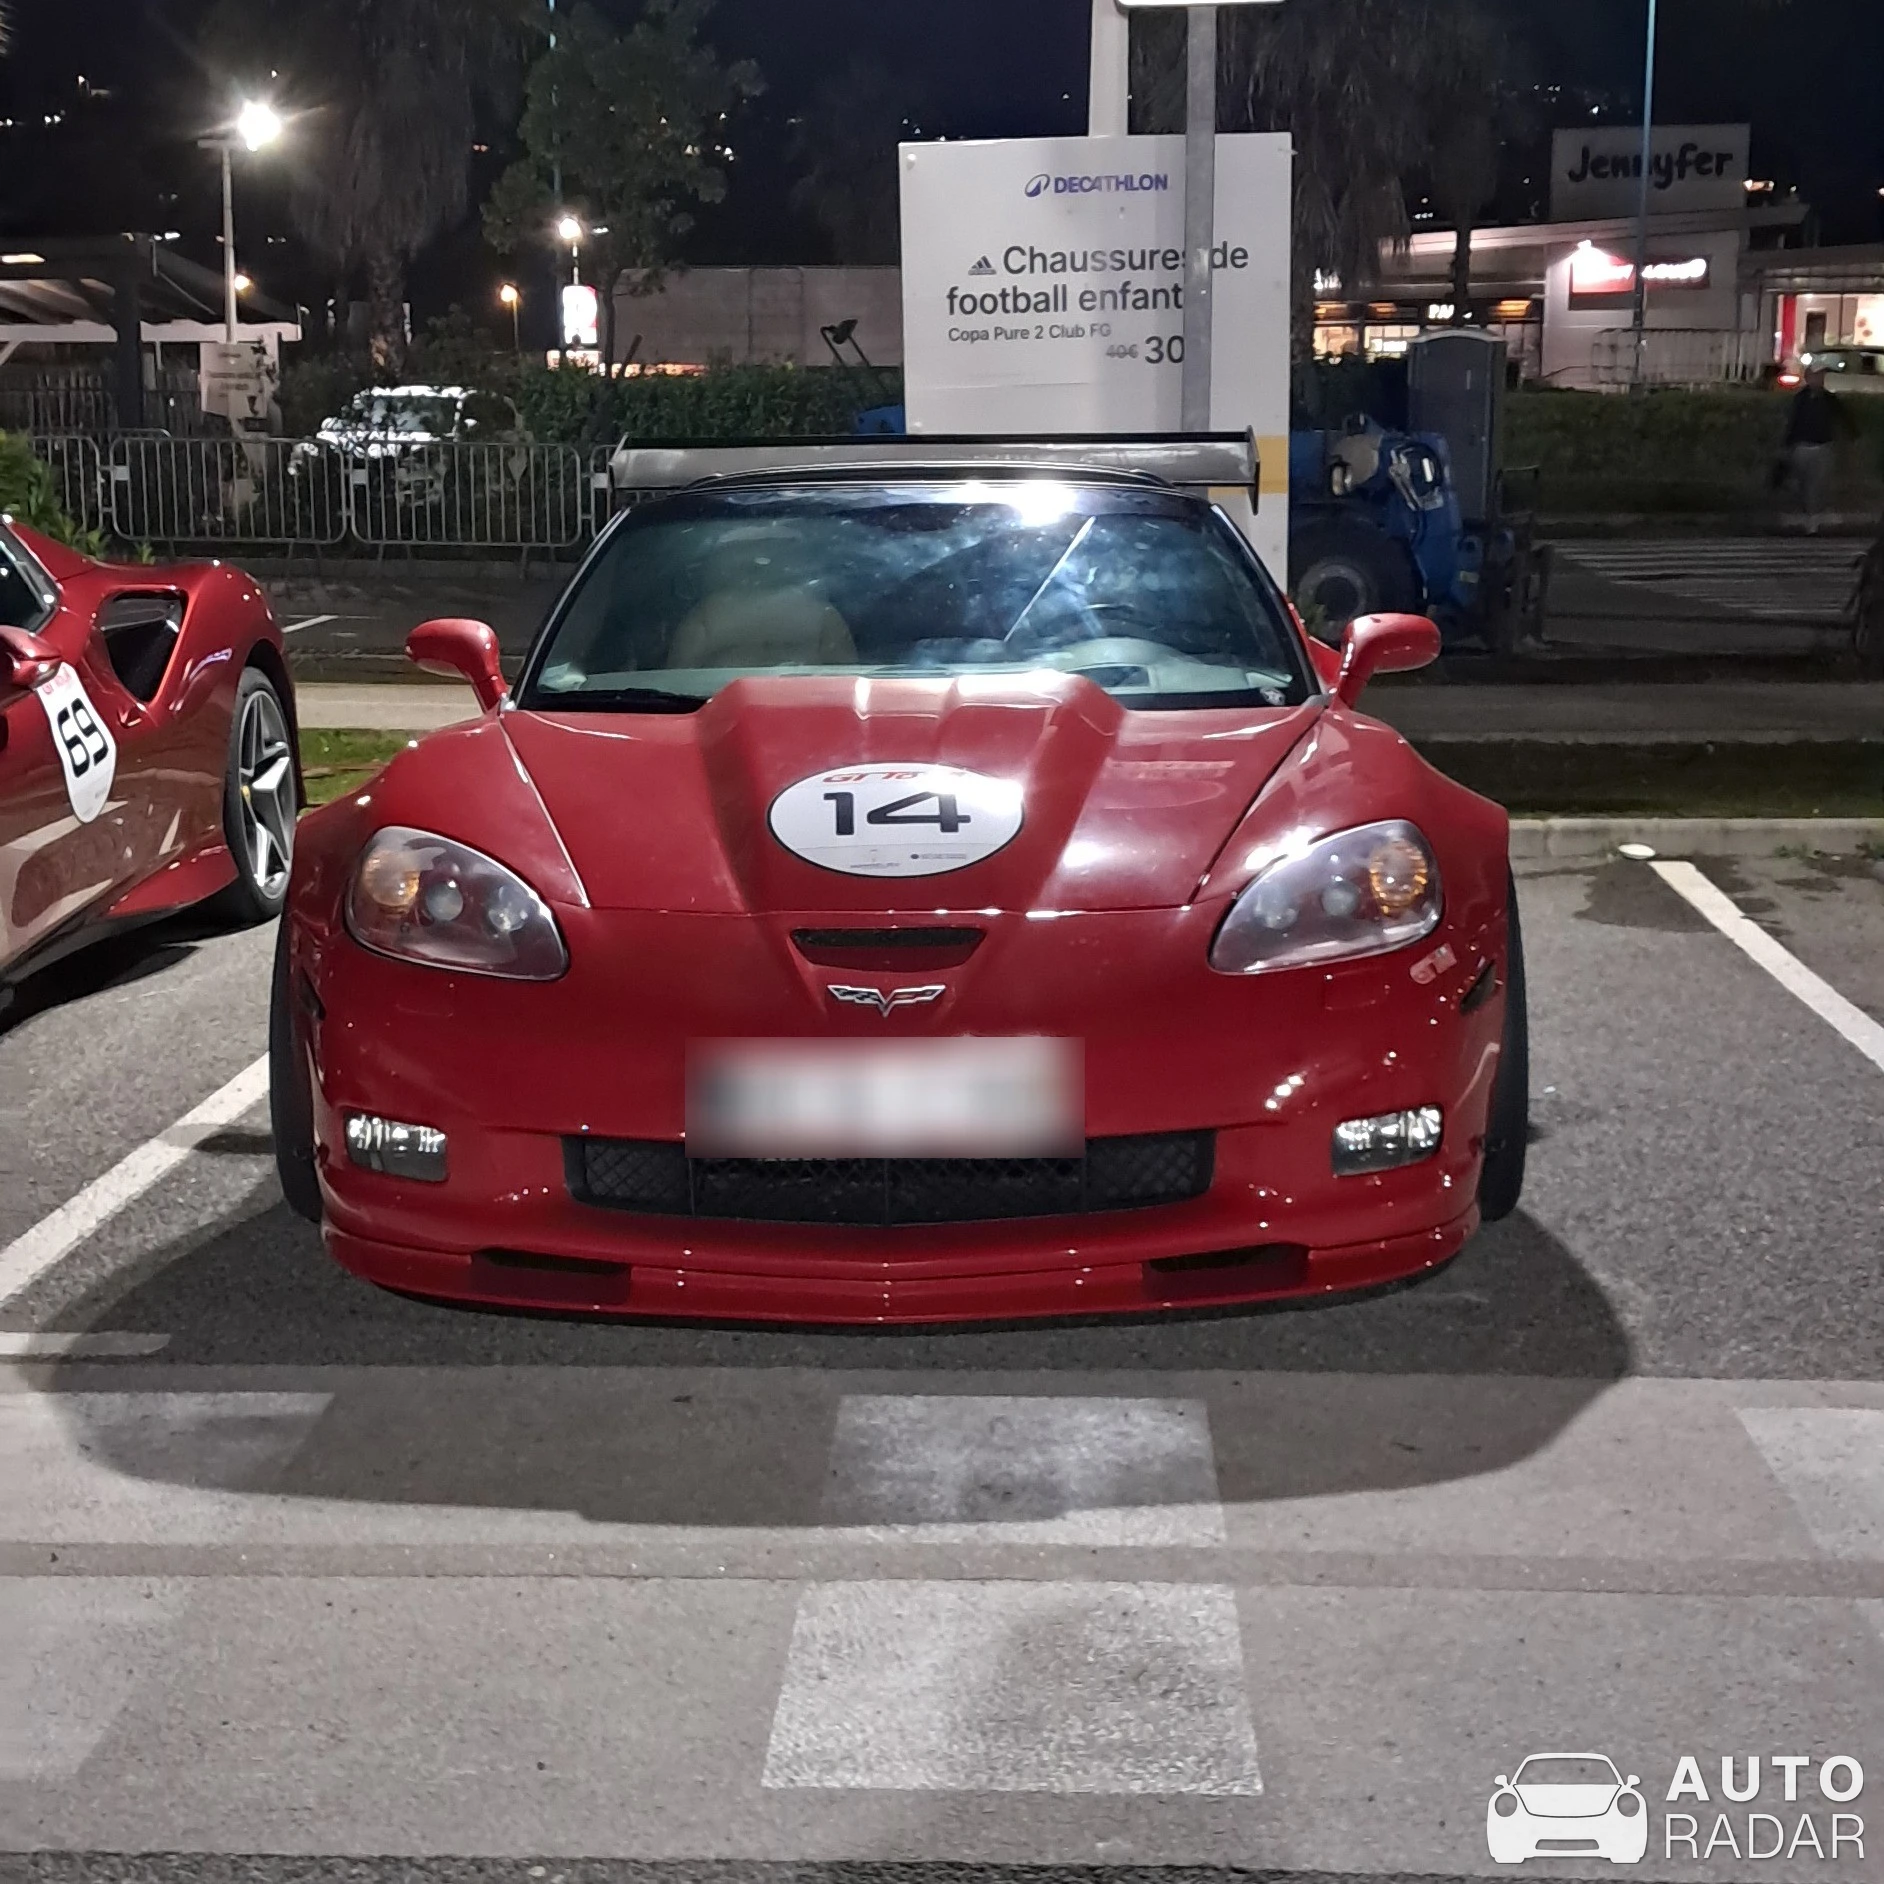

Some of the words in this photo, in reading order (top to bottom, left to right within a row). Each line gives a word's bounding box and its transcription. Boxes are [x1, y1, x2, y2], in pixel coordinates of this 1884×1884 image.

[1053, 173, 1168, 194] DECATHLON
[1003, 245, 1185, 274] Chaussure
[1211, 240, 1249, 268] de
[947, 282, 1067, 315] football
[1078, 279, 1184, 311] enfant
[947, 327, 989, 343] Copa
[994, 326, 1030, 340] Pure
[1034, 325, 1044, 339] 2
[1049, 324, 1085, 339] Club
[1090, 322, 1112, 337] FG
[1144, 335, 1185, 364] 30
[57, 697, 109, 778] 69
[823, 791, 971, 836] 14
